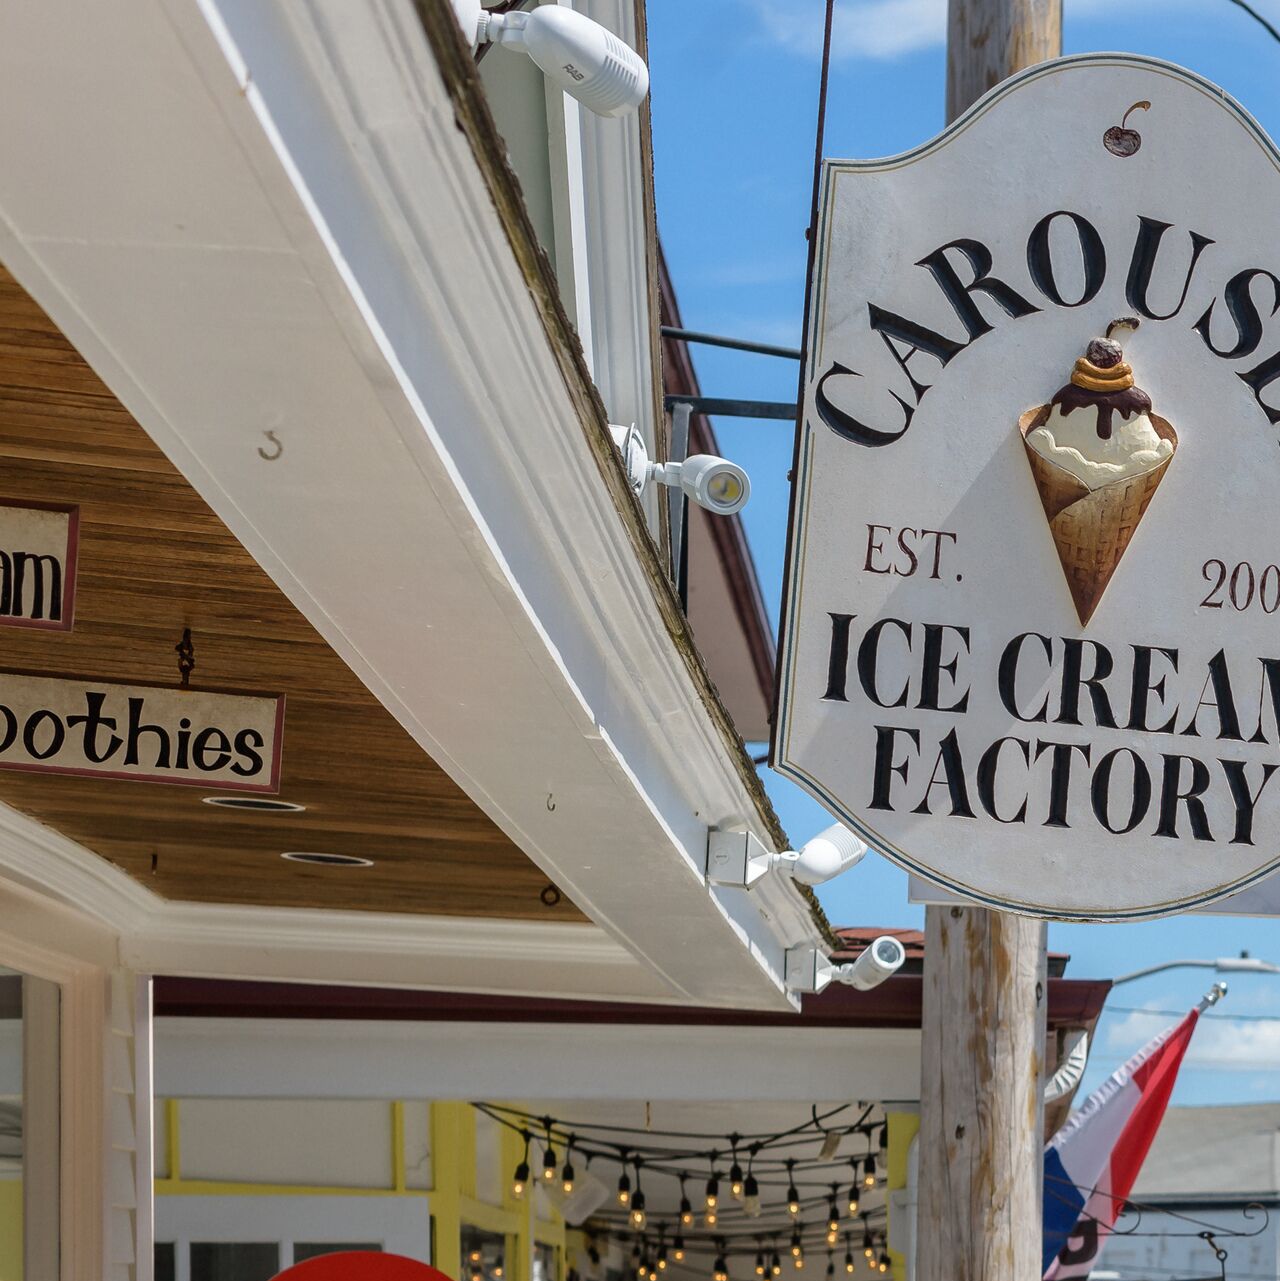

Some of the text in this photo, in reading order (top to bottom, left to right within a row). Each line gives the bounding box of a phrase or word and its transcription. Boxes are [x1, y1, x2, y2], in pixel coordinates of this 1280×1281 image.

[863, 524, 964, 583] EST.
[820, 612, 970, 714] ICE
[868, 724, 1279, 846] FACTORY
